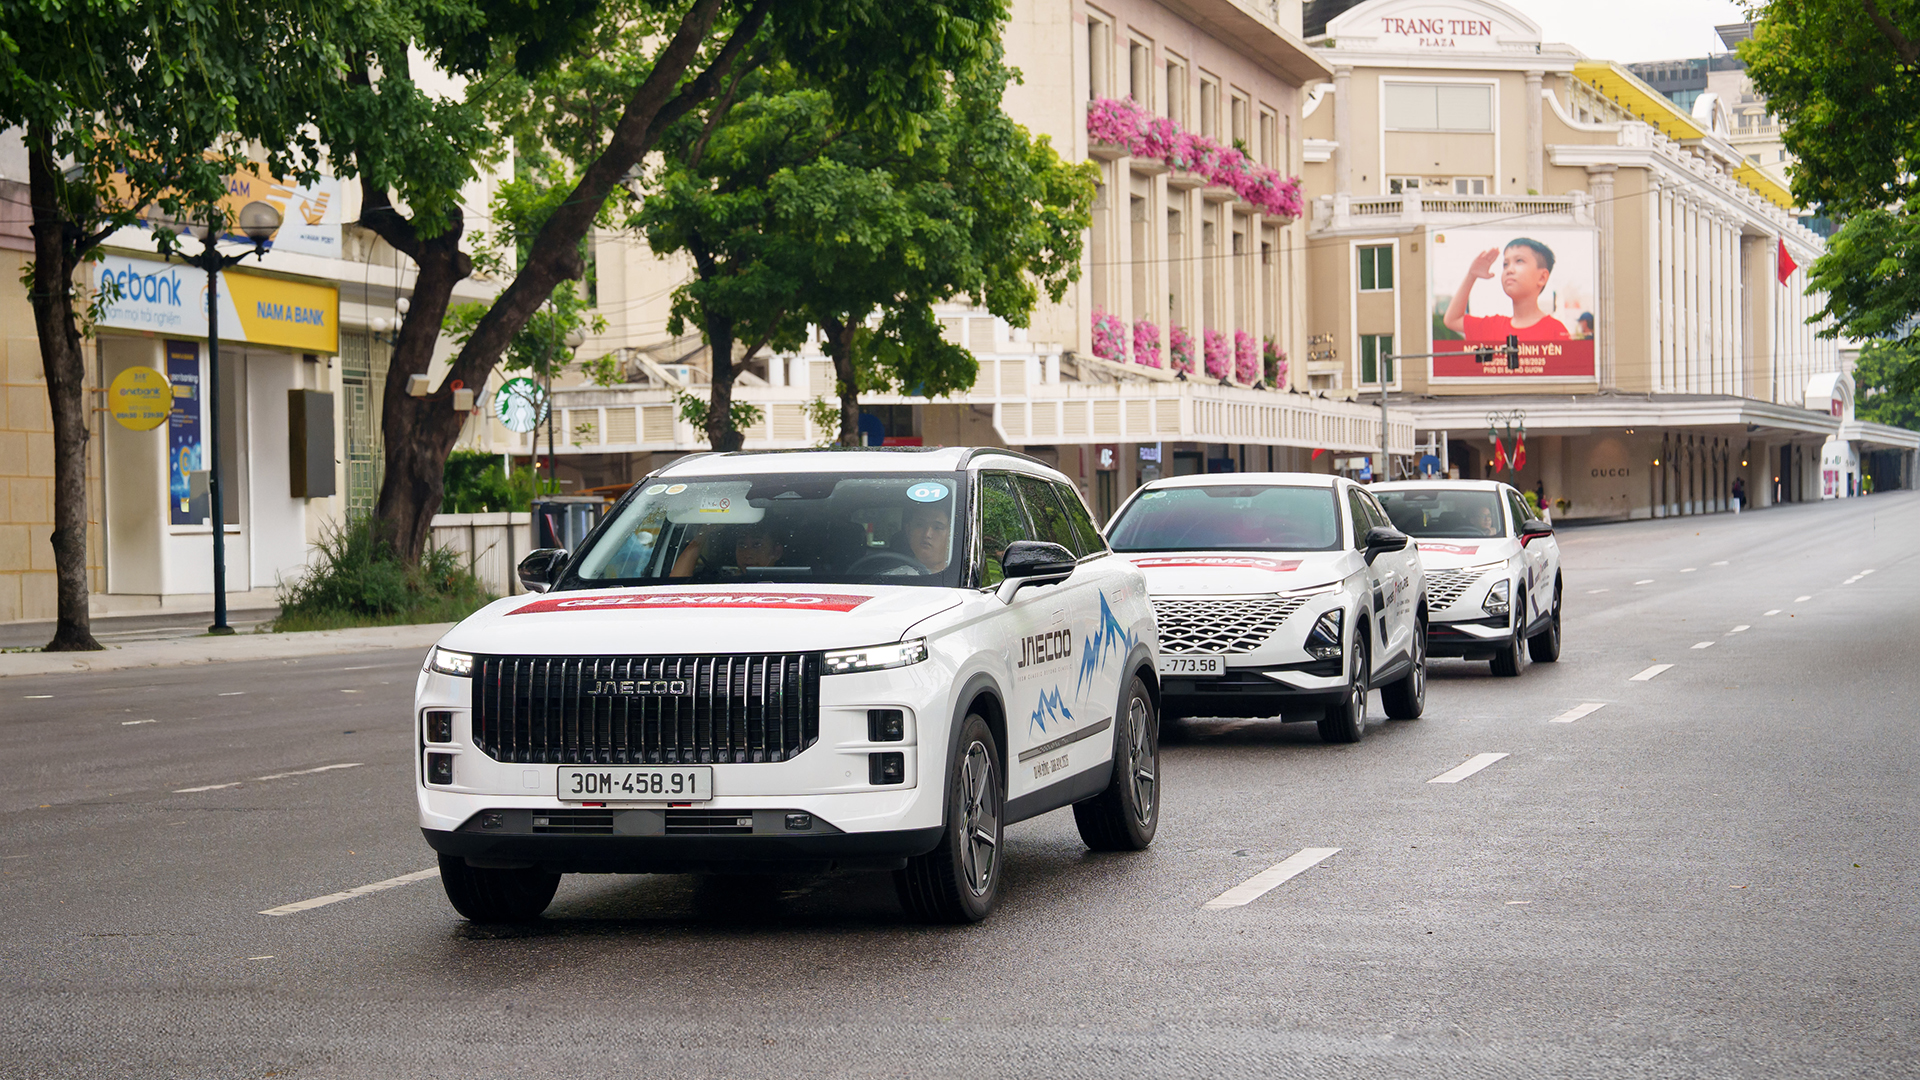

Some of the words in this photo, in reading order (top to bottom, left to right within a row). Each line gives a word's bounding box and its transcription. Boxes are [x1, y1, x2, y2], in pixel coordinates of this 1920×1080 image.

[1381, 17, 1444, 36] TRANG
[1448, 19, 1492, 36] TIEN
[1419, 37, 1455, 47] PLAZA
[229, 179, 250, 198] AM
[257, 300, 283, 321] NAM
[285, 305, 293, 322] A
[295, 306, 325, 327] BANK
[1541, 342, 1562, 355] YÊN
[1591, 468, 1630, 477] GUCCI
[914, 488, 941, 498] 01
[557, 595, 824, 607] GELEXIMCO
[1017, 628, 1072, 668] JAECOO
[587, 680, 685, 695] JAECOO
[571, 773, 696, 794] 30M-458.91
